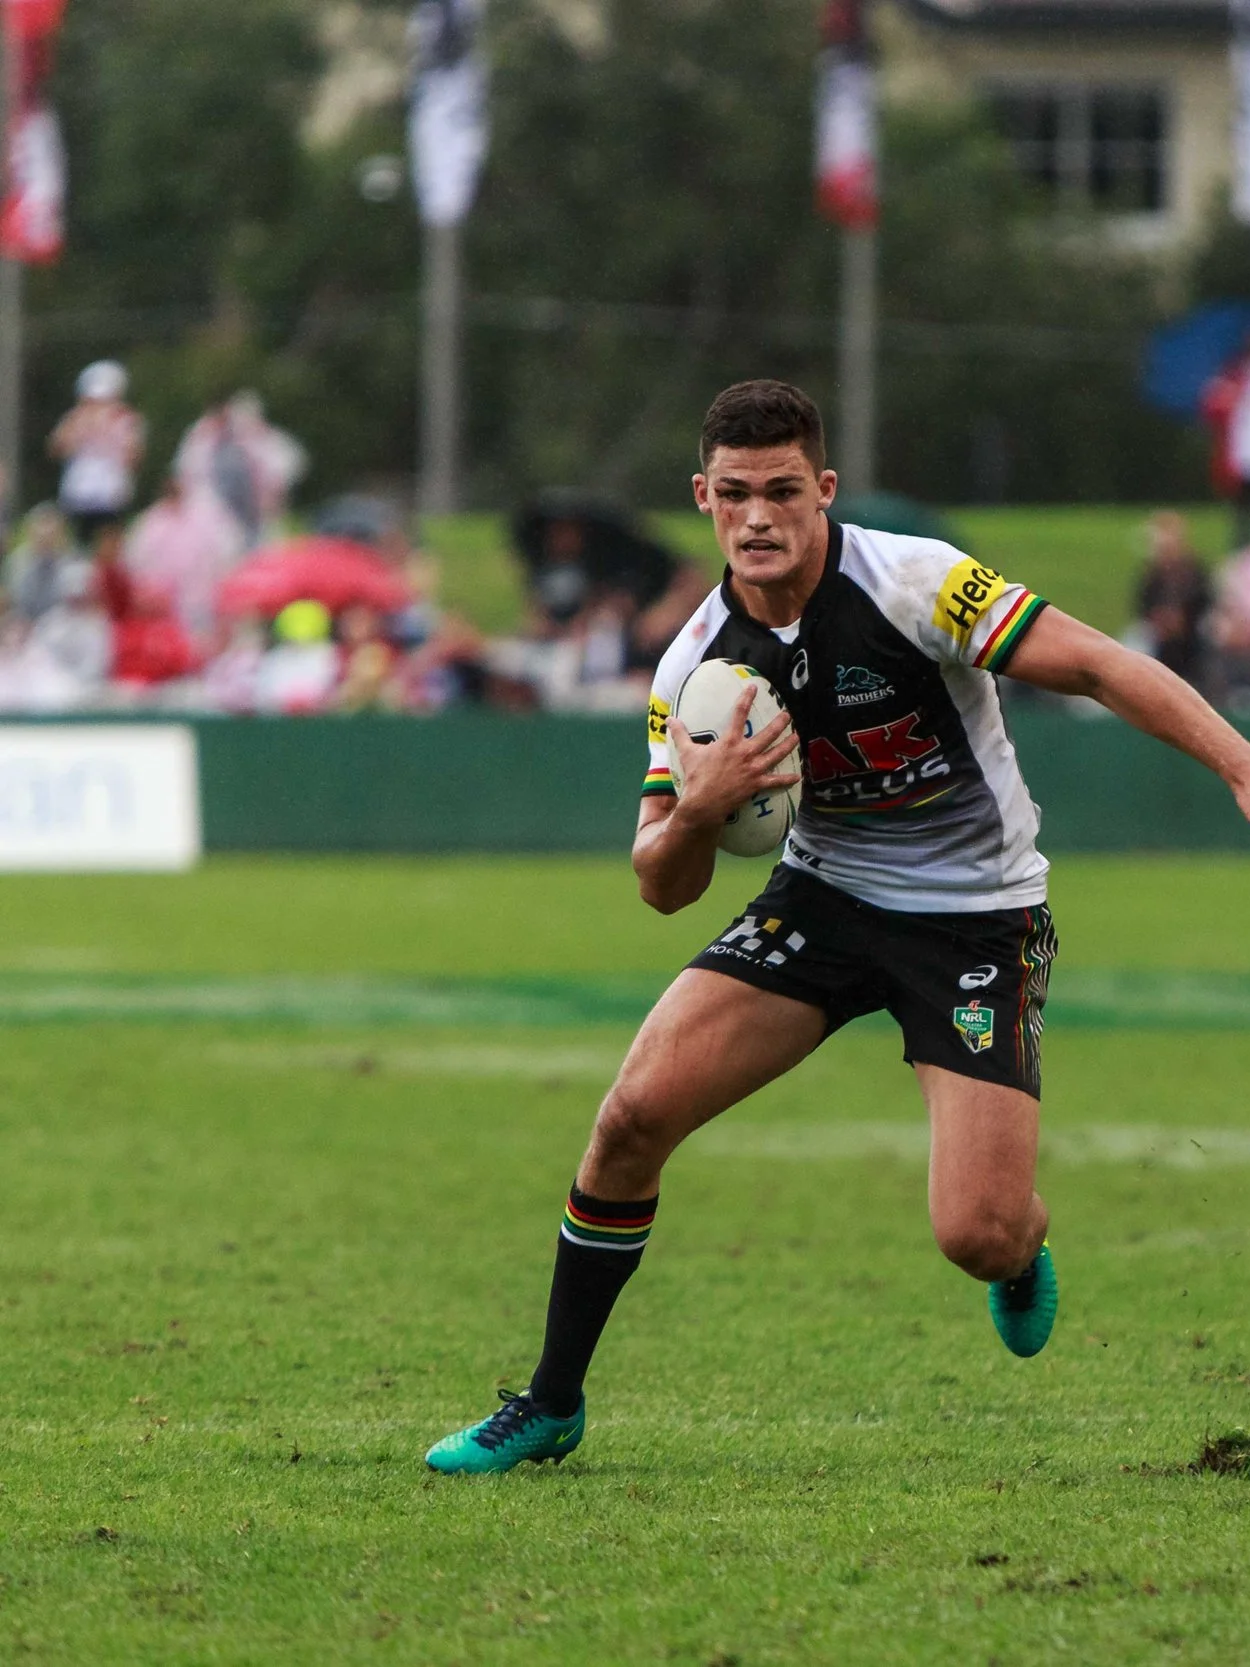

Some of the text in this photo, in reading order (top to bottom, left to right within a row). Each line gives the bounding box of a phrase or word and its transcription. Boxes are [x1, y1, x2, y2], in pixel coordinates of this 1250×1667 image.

[946, 567, 1001, 630] Her
[837, 685, 896, 705] PANTHERS
[808, 711, 940, 784] AK
[960, 1012, 987, 1023] NRL
